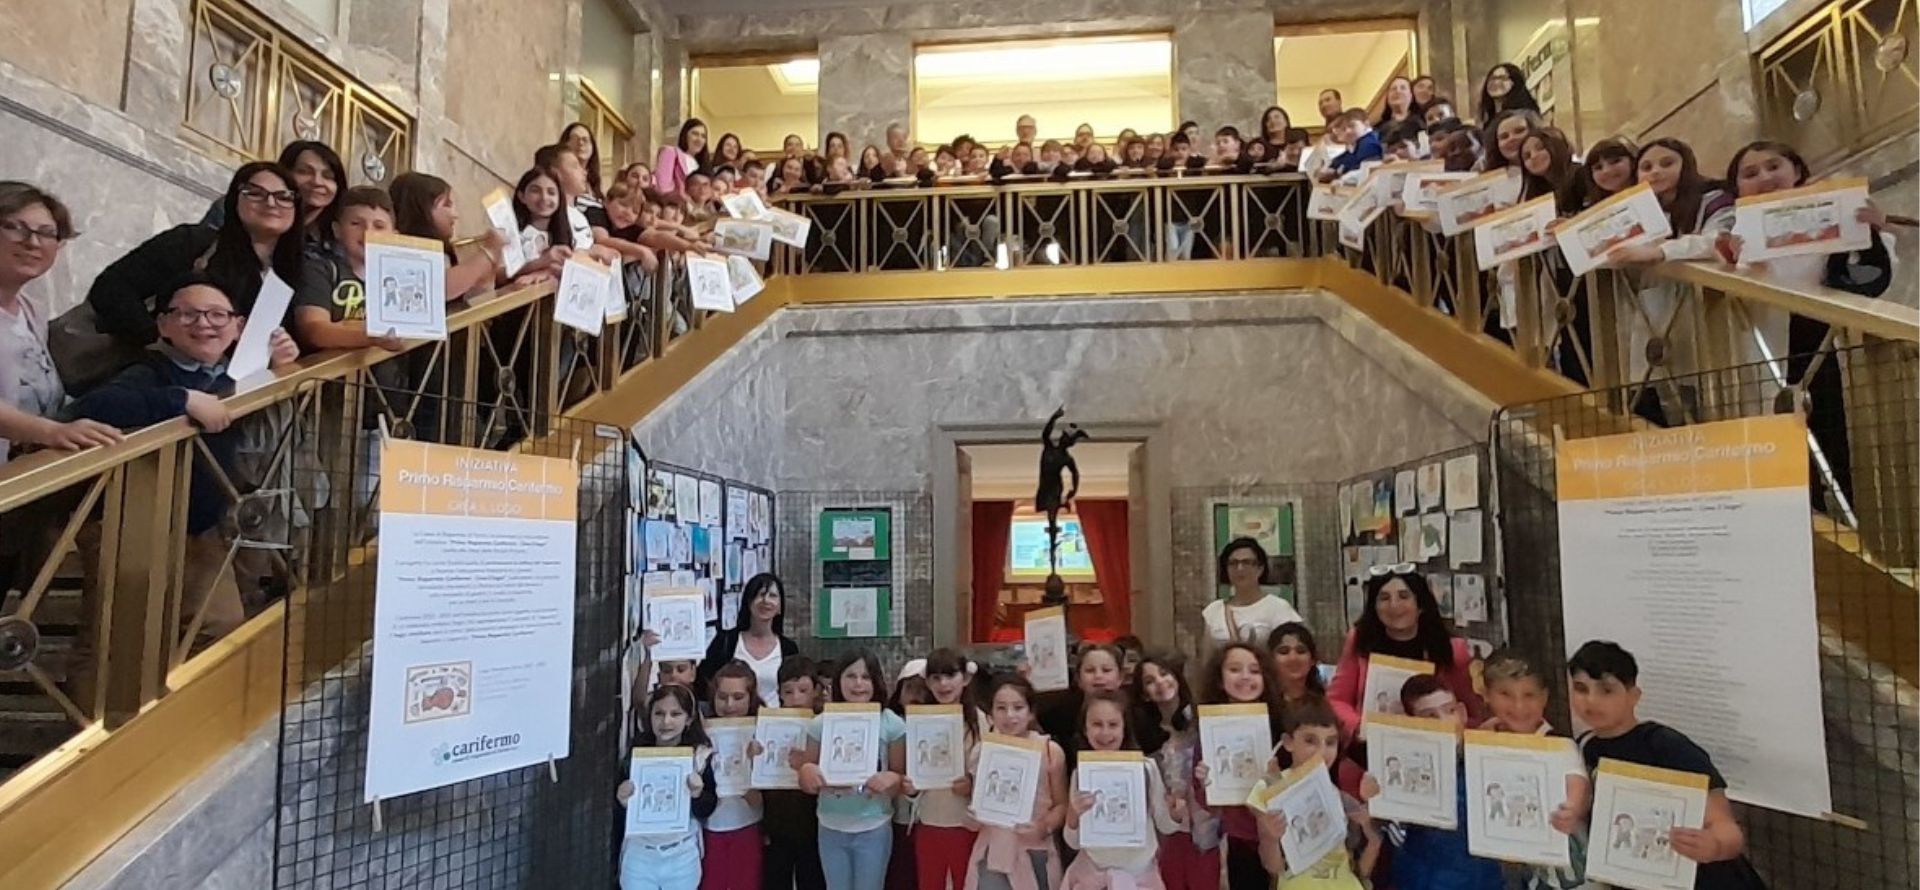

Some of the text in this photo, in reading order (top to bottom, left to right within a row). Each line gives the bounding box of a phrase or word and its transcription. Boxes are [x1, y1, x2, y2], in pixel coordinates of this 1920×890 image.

[455, 457, 519, 473] INIZIATIVA
[399, 468, 563, 495] Primo Risparmio Carifermo
[452, 733, 521, 757] carifermo
